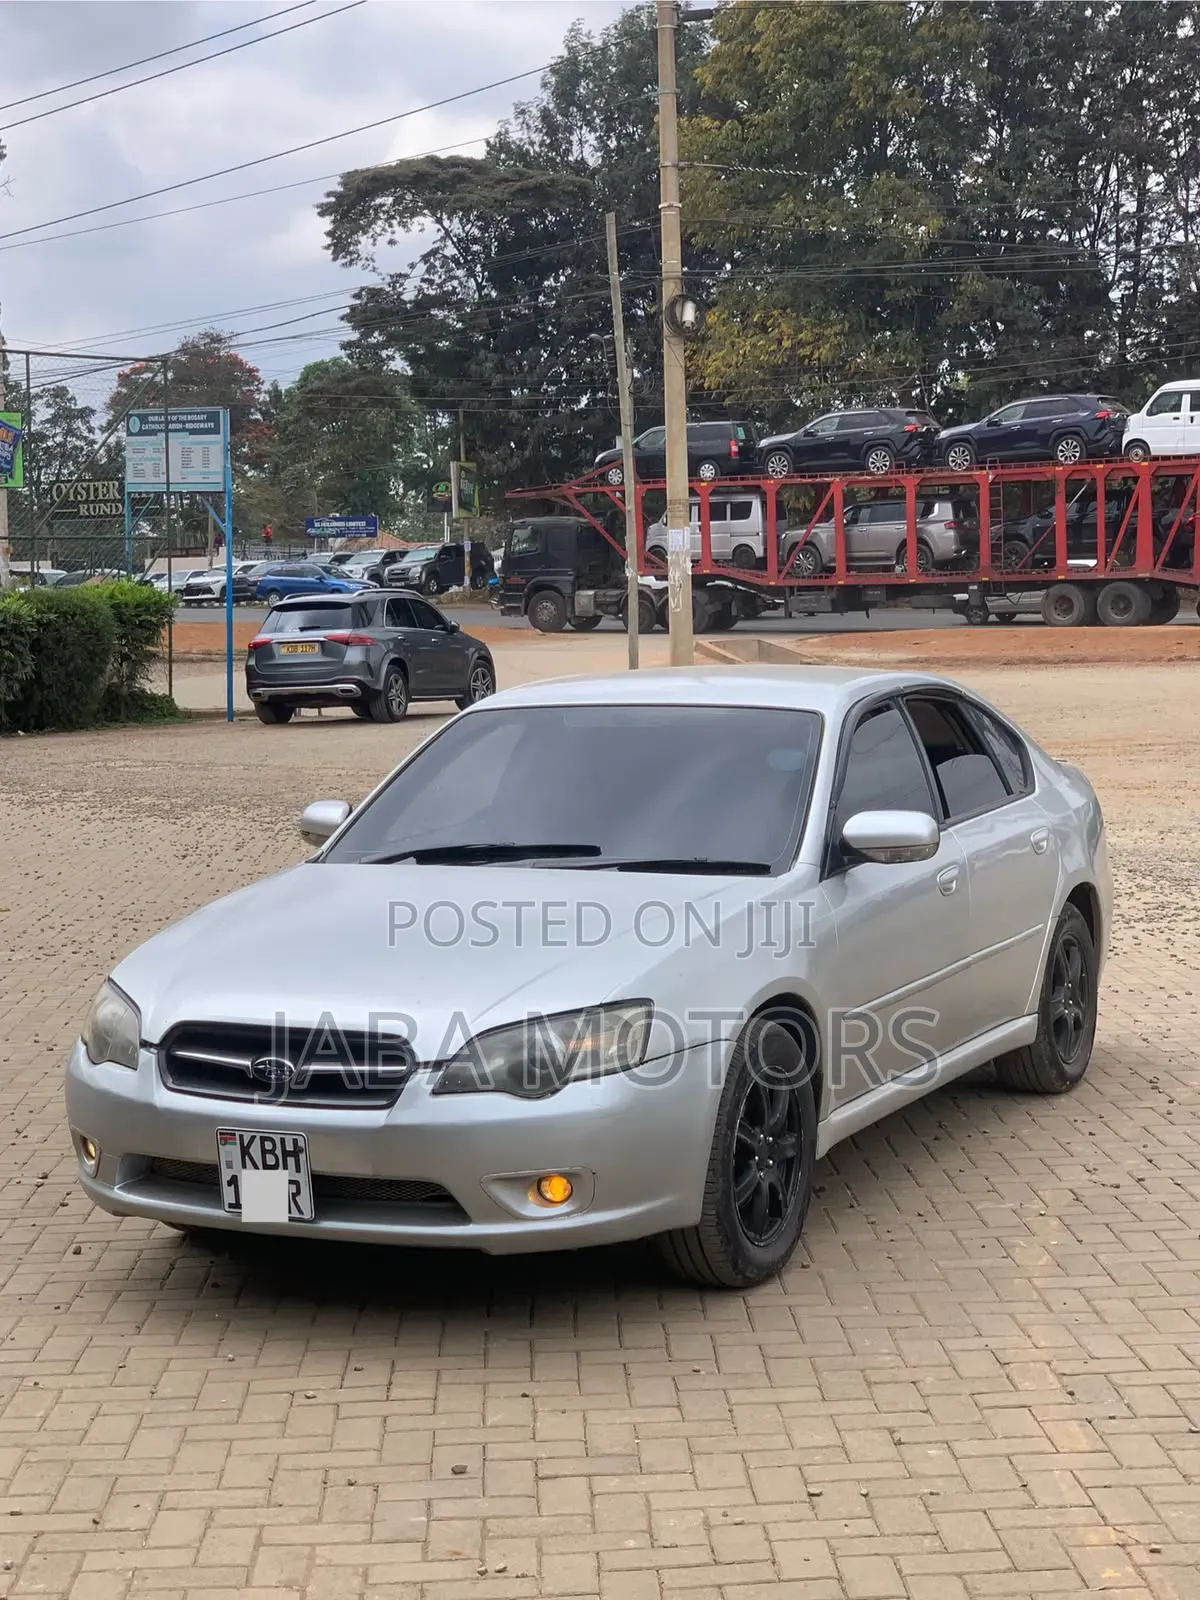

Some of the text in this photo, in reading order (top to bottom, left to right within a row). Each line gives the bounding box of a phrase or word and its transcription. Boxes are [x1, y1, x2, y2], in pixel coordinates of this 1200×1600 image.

[52, 481, 121, 501] OYSTER
[239, 1134, 302, 1173] KBH
[226, 1174, 304, 1215] 1R
